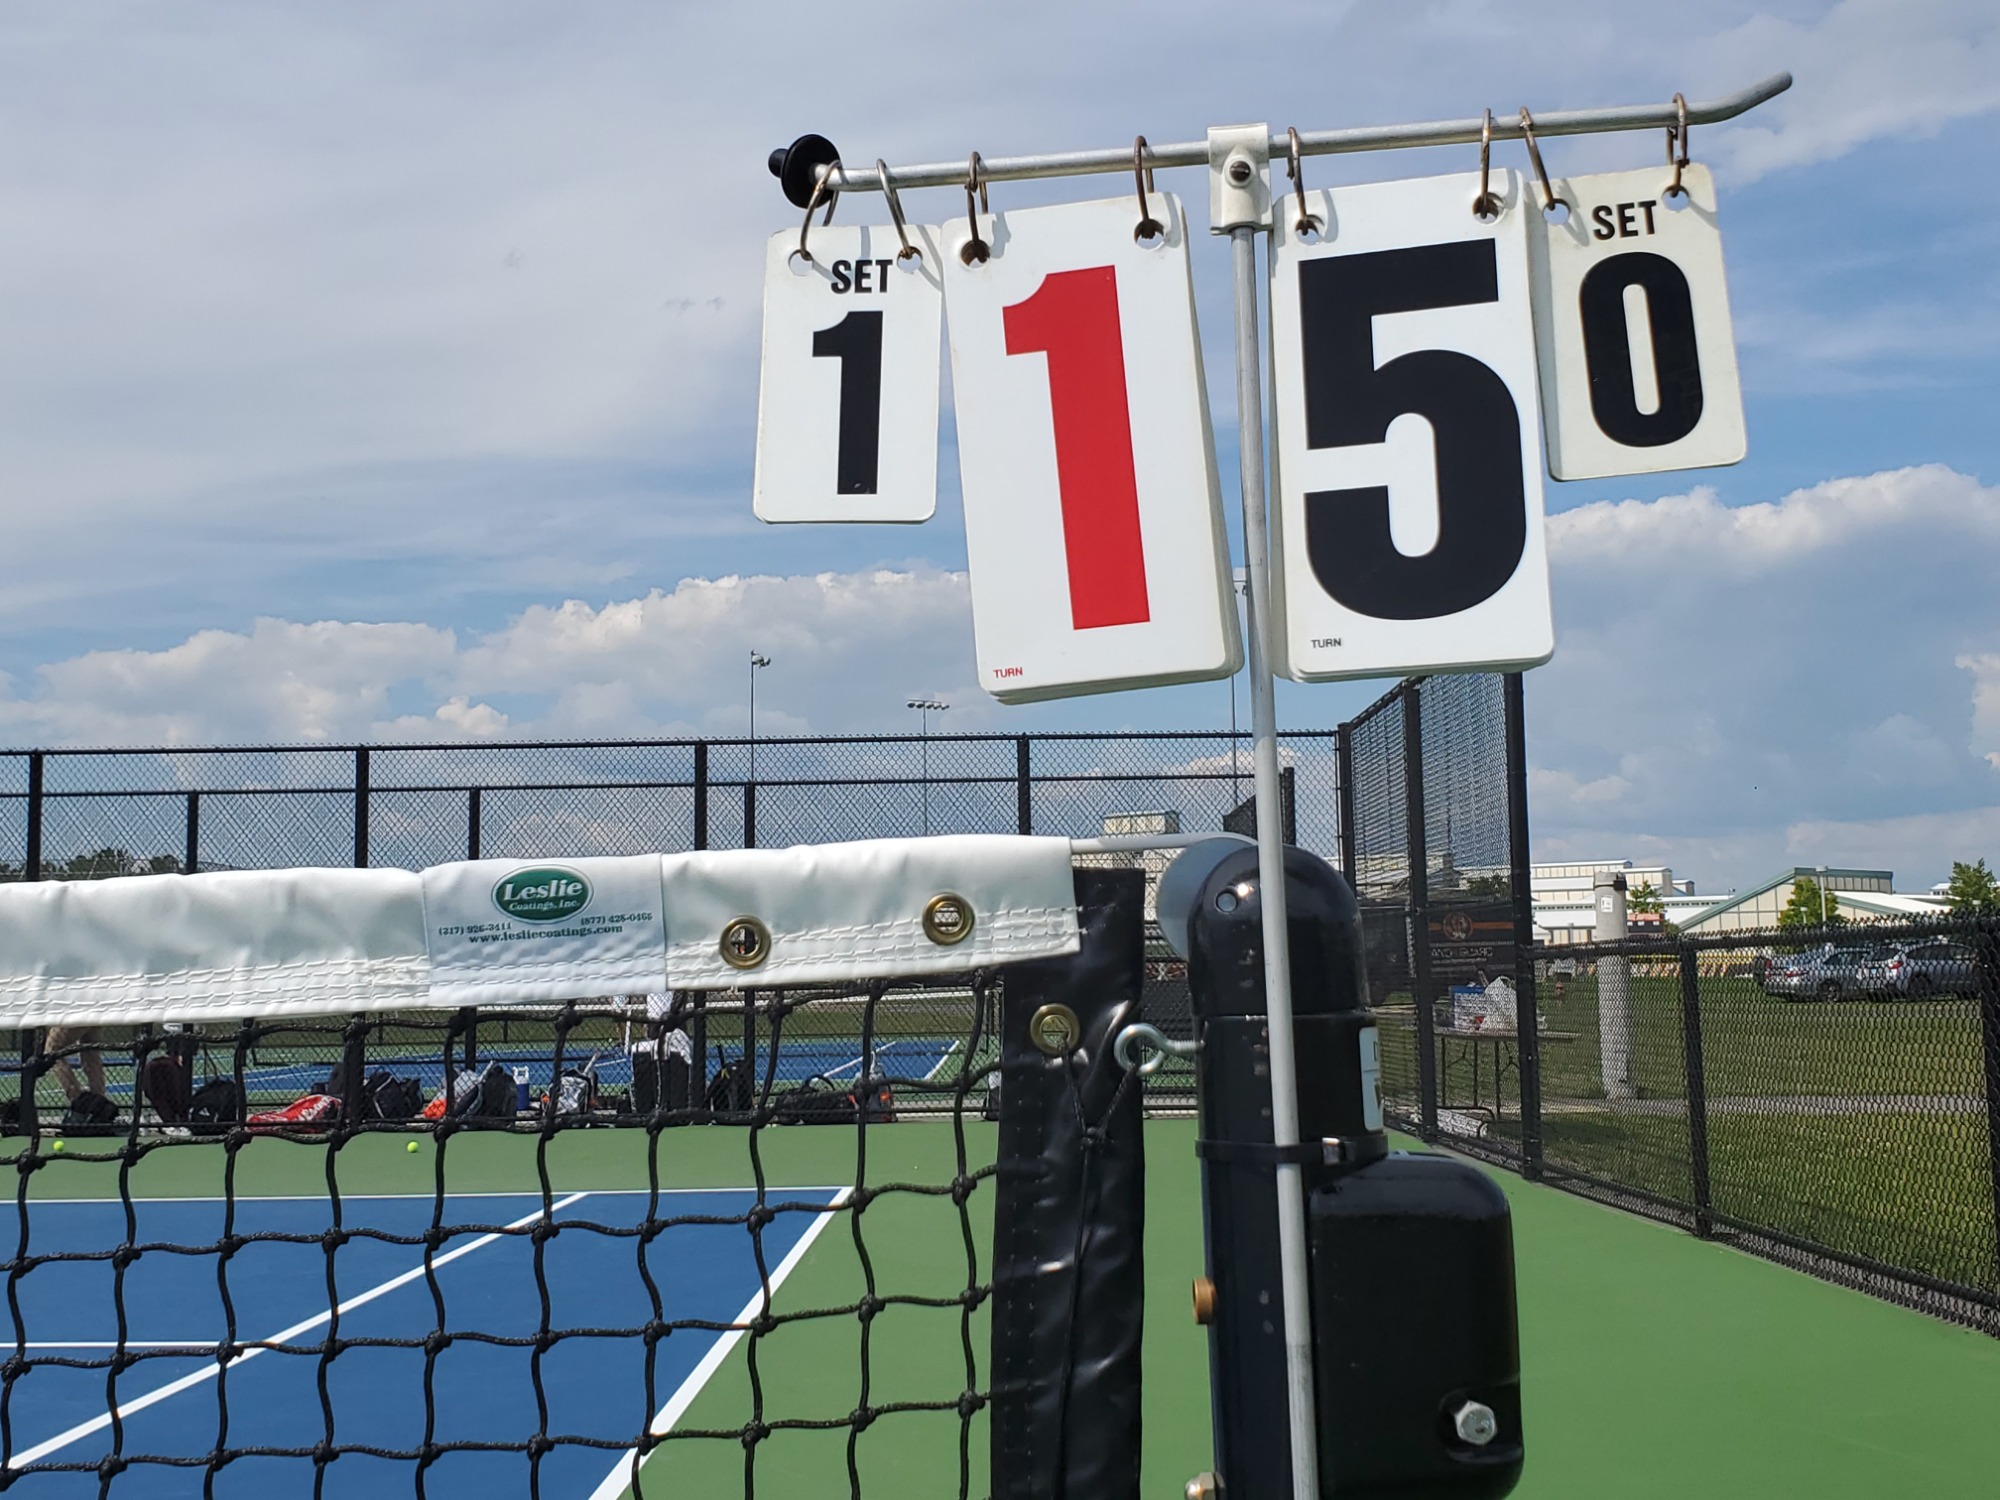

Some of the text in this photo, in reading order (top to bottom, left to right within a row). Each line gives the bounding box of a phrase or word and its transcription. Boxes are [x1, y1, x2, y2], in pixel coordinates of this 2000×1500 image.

[1593, 199, 1657, 241] SET
[830, 259, 893, 294] SET
[1578, 251, 1704, 448] 0
[812, 310, 884, 495] 1
[1298, 237, 1527, 621] 5
[1002, 265, 1151, 631] 1
[1310, 637, 1342, 649] TURN
[992, 666, 1023, 679] TURN
[503, 879, 583, 901] Leslie
[559, 899, 582, 909] Inc.
[468, 925, 623, 944] www.lesliecoatings.com
[581, 915, 606, 926] (877)
